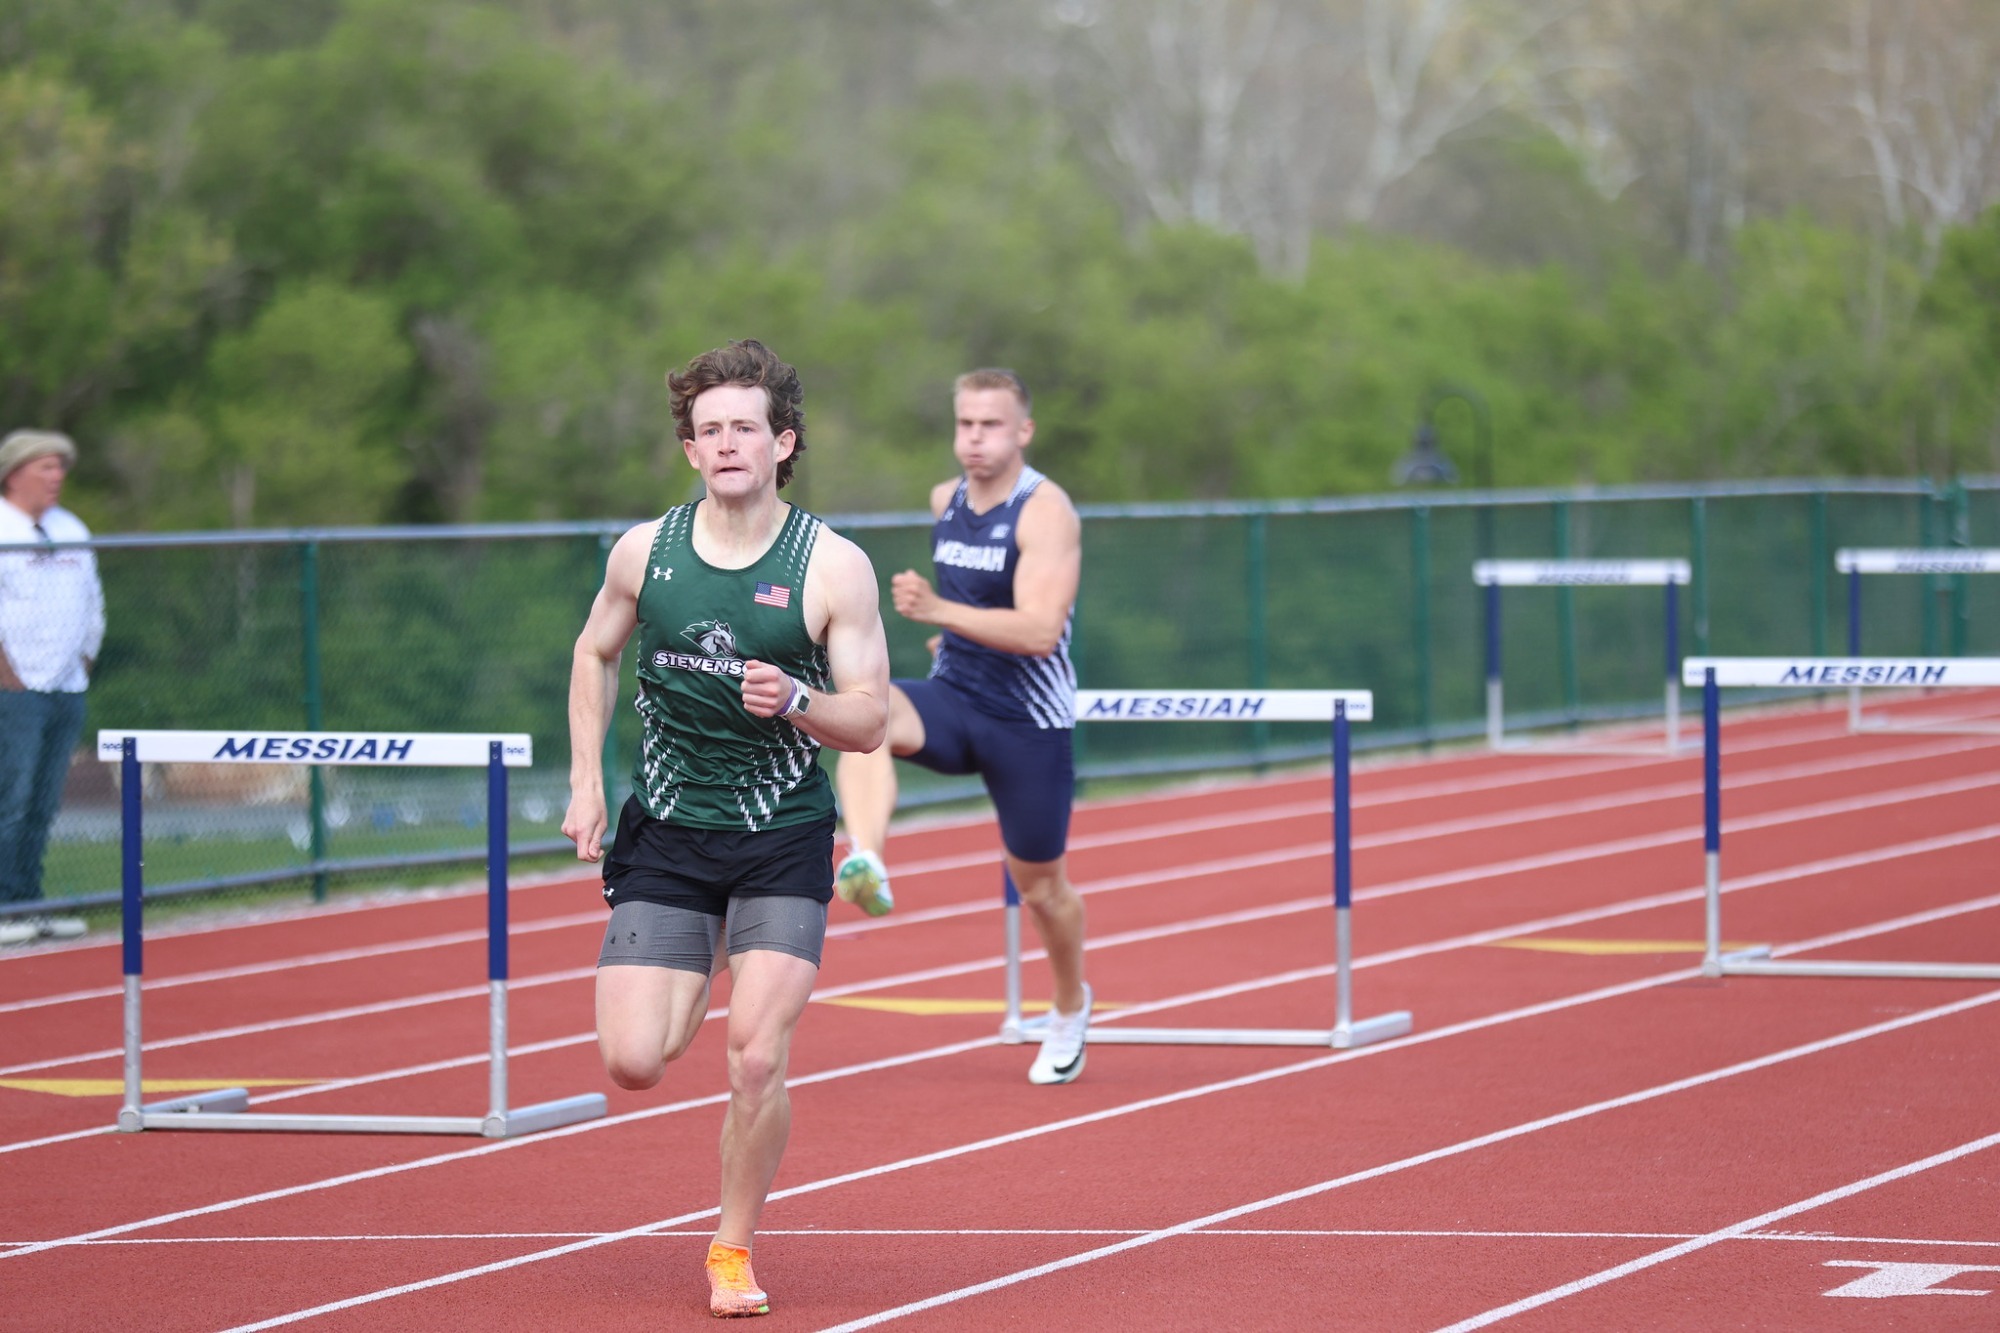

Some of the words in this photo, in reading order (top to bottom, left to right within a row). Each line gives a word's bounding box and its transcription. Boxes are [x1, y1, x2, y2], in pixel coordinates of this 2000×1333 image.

[933, 538, 1007, 572] MESSIAH
[653, 650, 746, 676] STEVENS
[1779, 665, 1949, 685] MESSIAH
[1086, 697, 1266, 717] MESSIAH
[212, 737, 414, 760] MESSIAH
